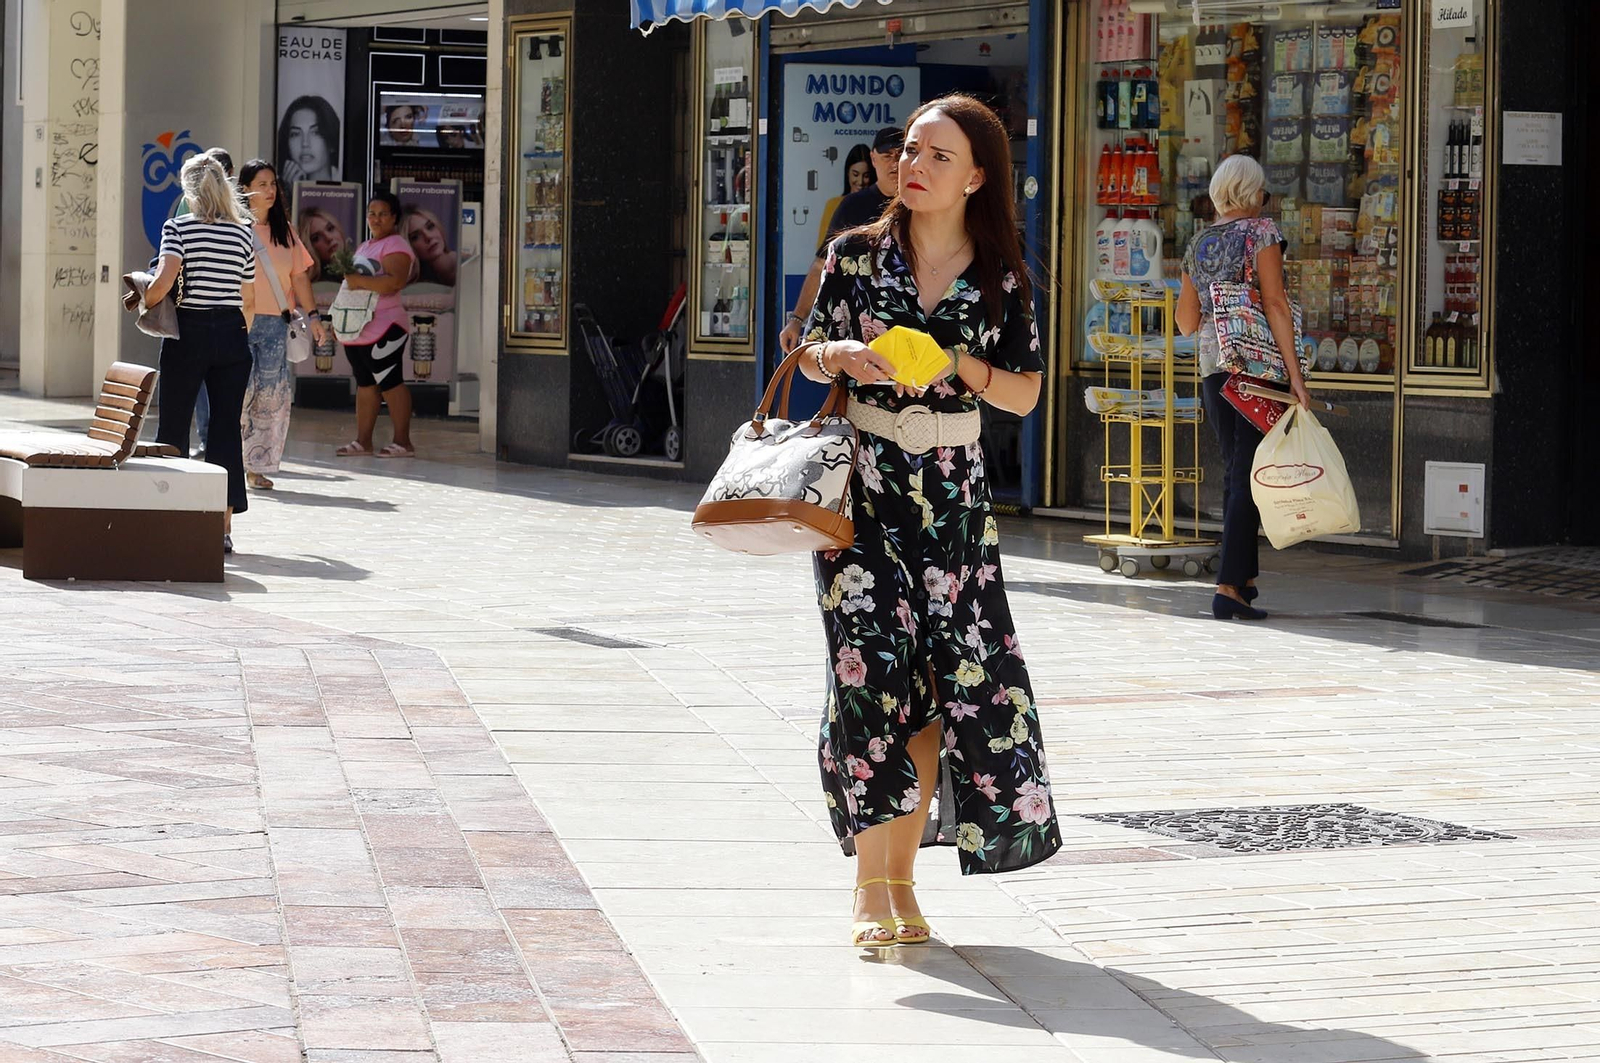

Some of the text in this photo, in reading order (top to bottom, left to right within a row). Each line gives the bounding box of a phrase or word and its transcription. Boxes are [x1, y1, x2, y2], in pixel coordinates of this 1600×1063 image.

[1438, 6, 1468, 22] Hilado
[279, 36, 342, 49] EAU DE
[279, 49, 342, 61] ROCHAS
[805, 74, 905, 98] MUNDO
[812, 101, 896, 124] MOVIL
[1315, 124, 1340, 134] PULEVA
[301, 190, 321, 198] paco
[421, 187, 456, 195] rabanne
